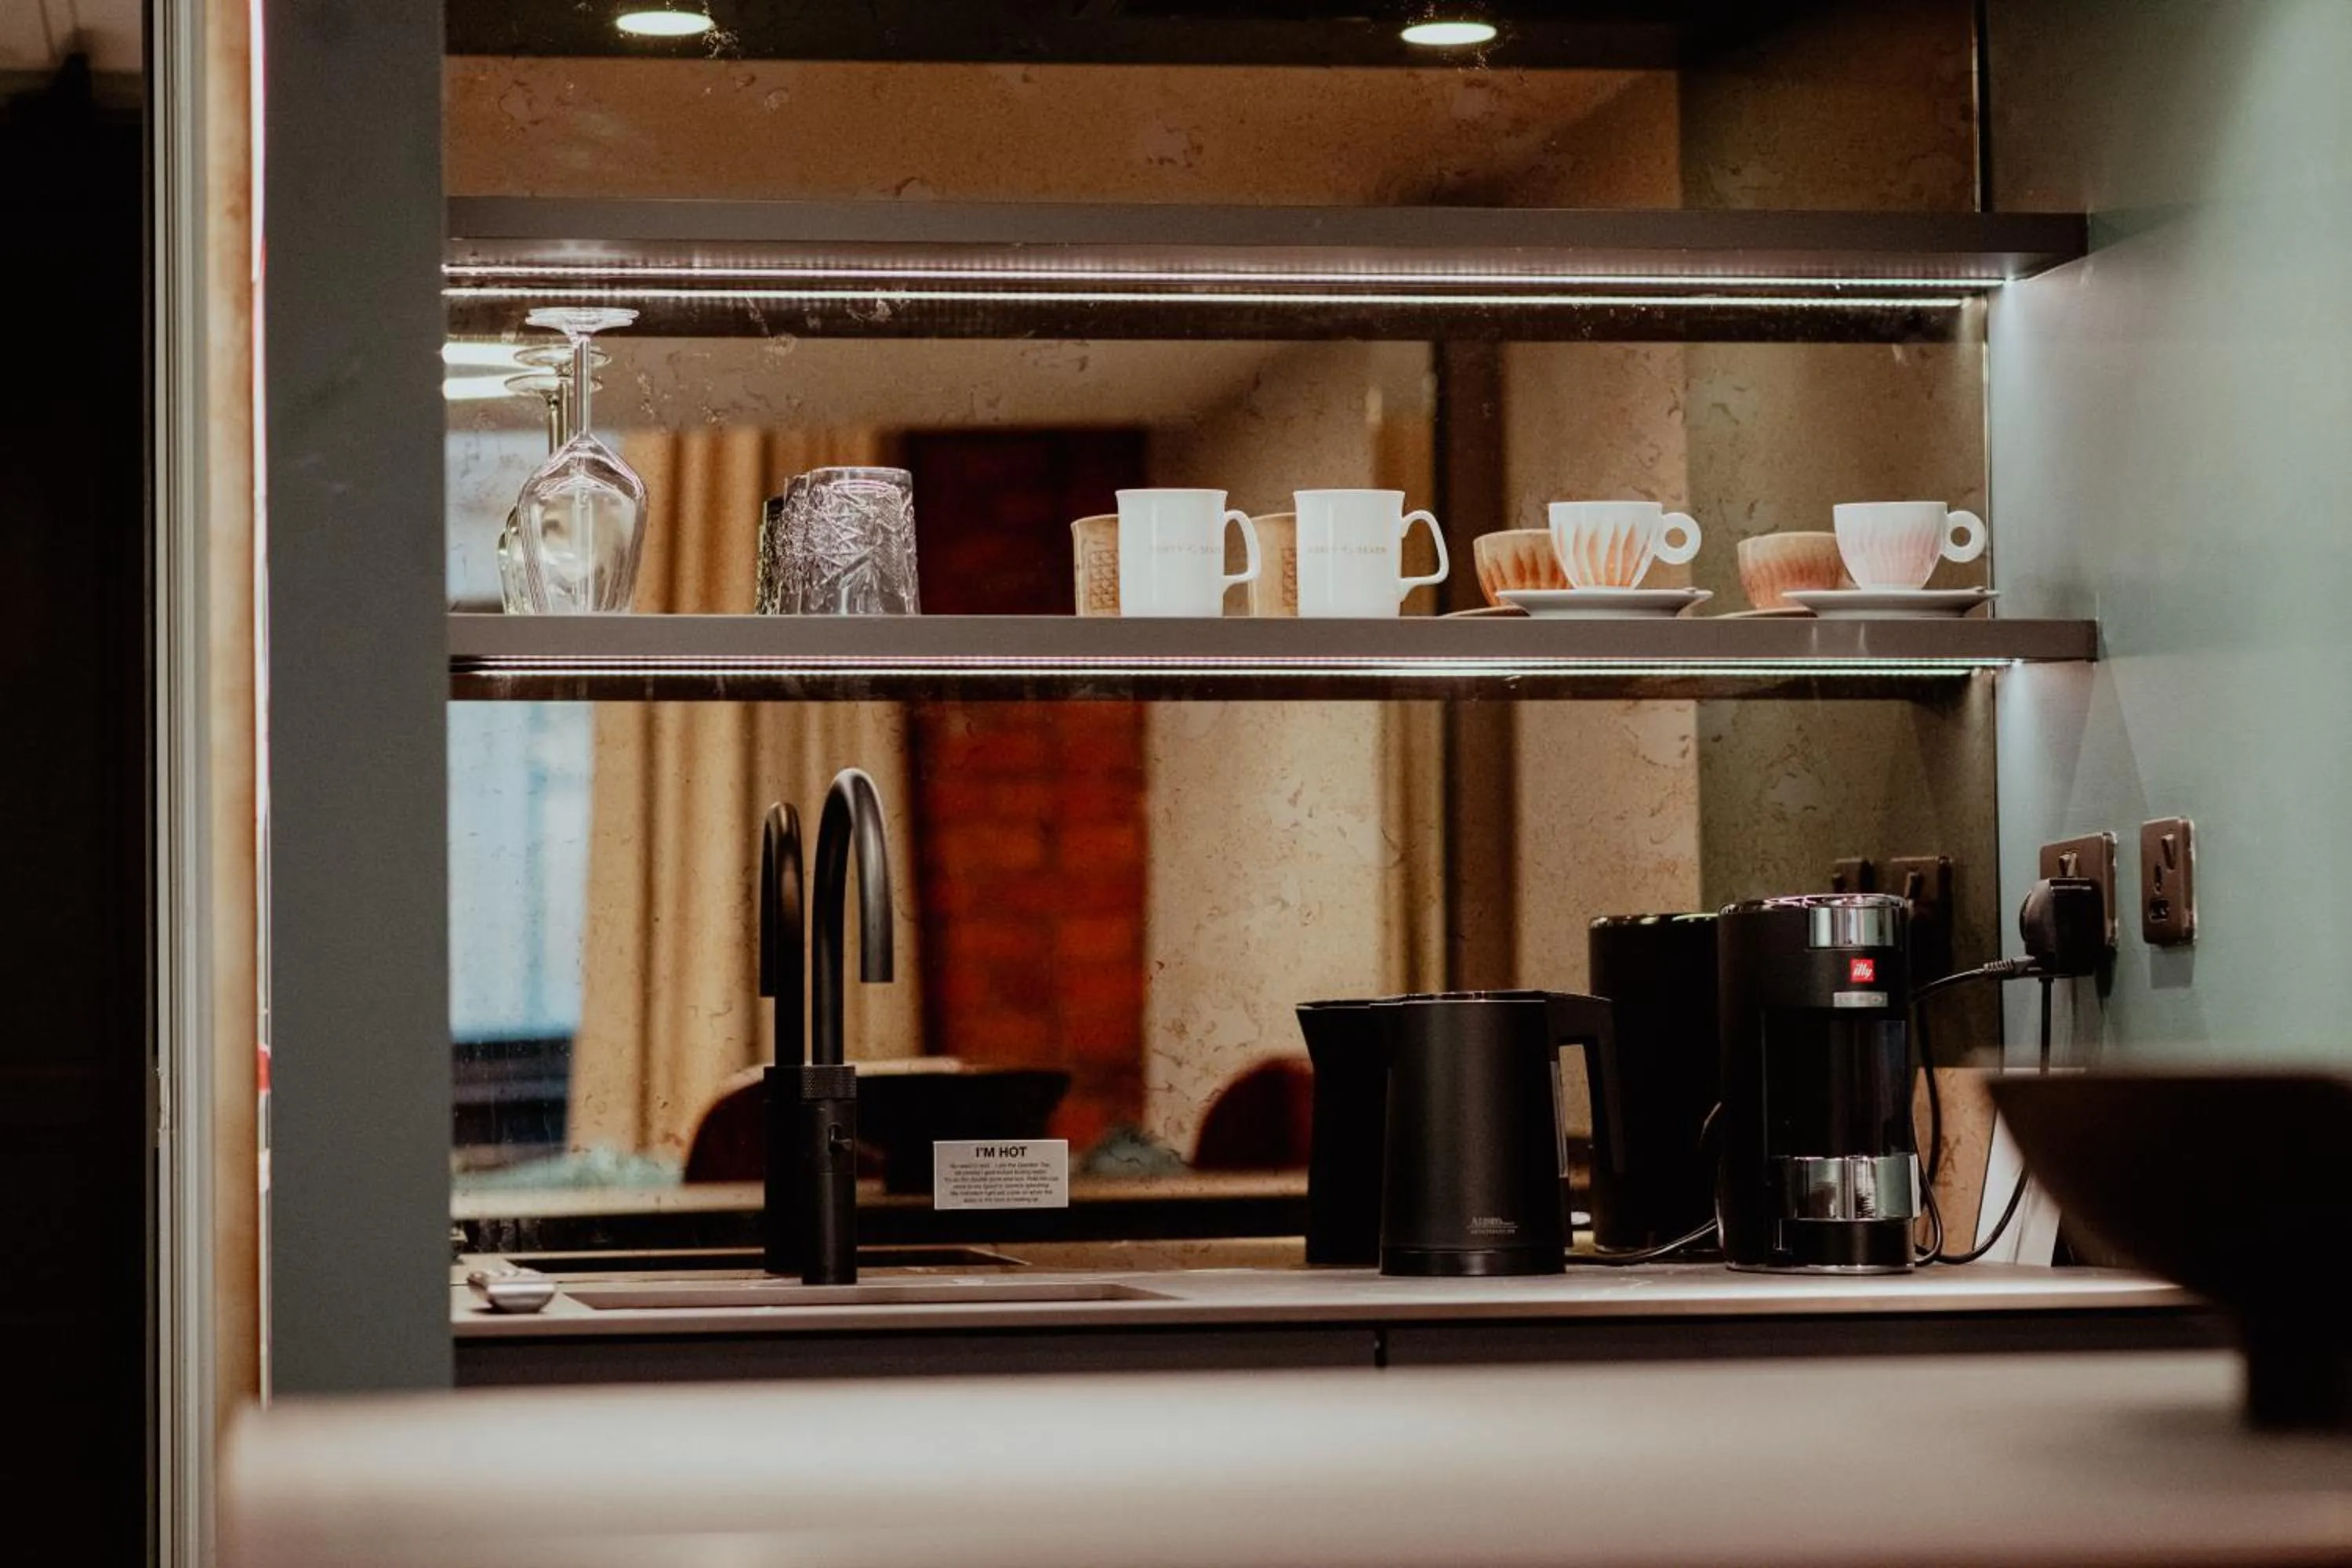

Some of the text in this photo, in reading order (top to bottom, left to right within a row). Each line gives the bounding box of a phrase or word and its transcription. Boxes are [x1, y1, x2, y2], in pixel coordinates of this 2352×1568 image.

[1853, 963, 1873, 979] illy
[976, 1145, 1028, 1158] I'M HOT
